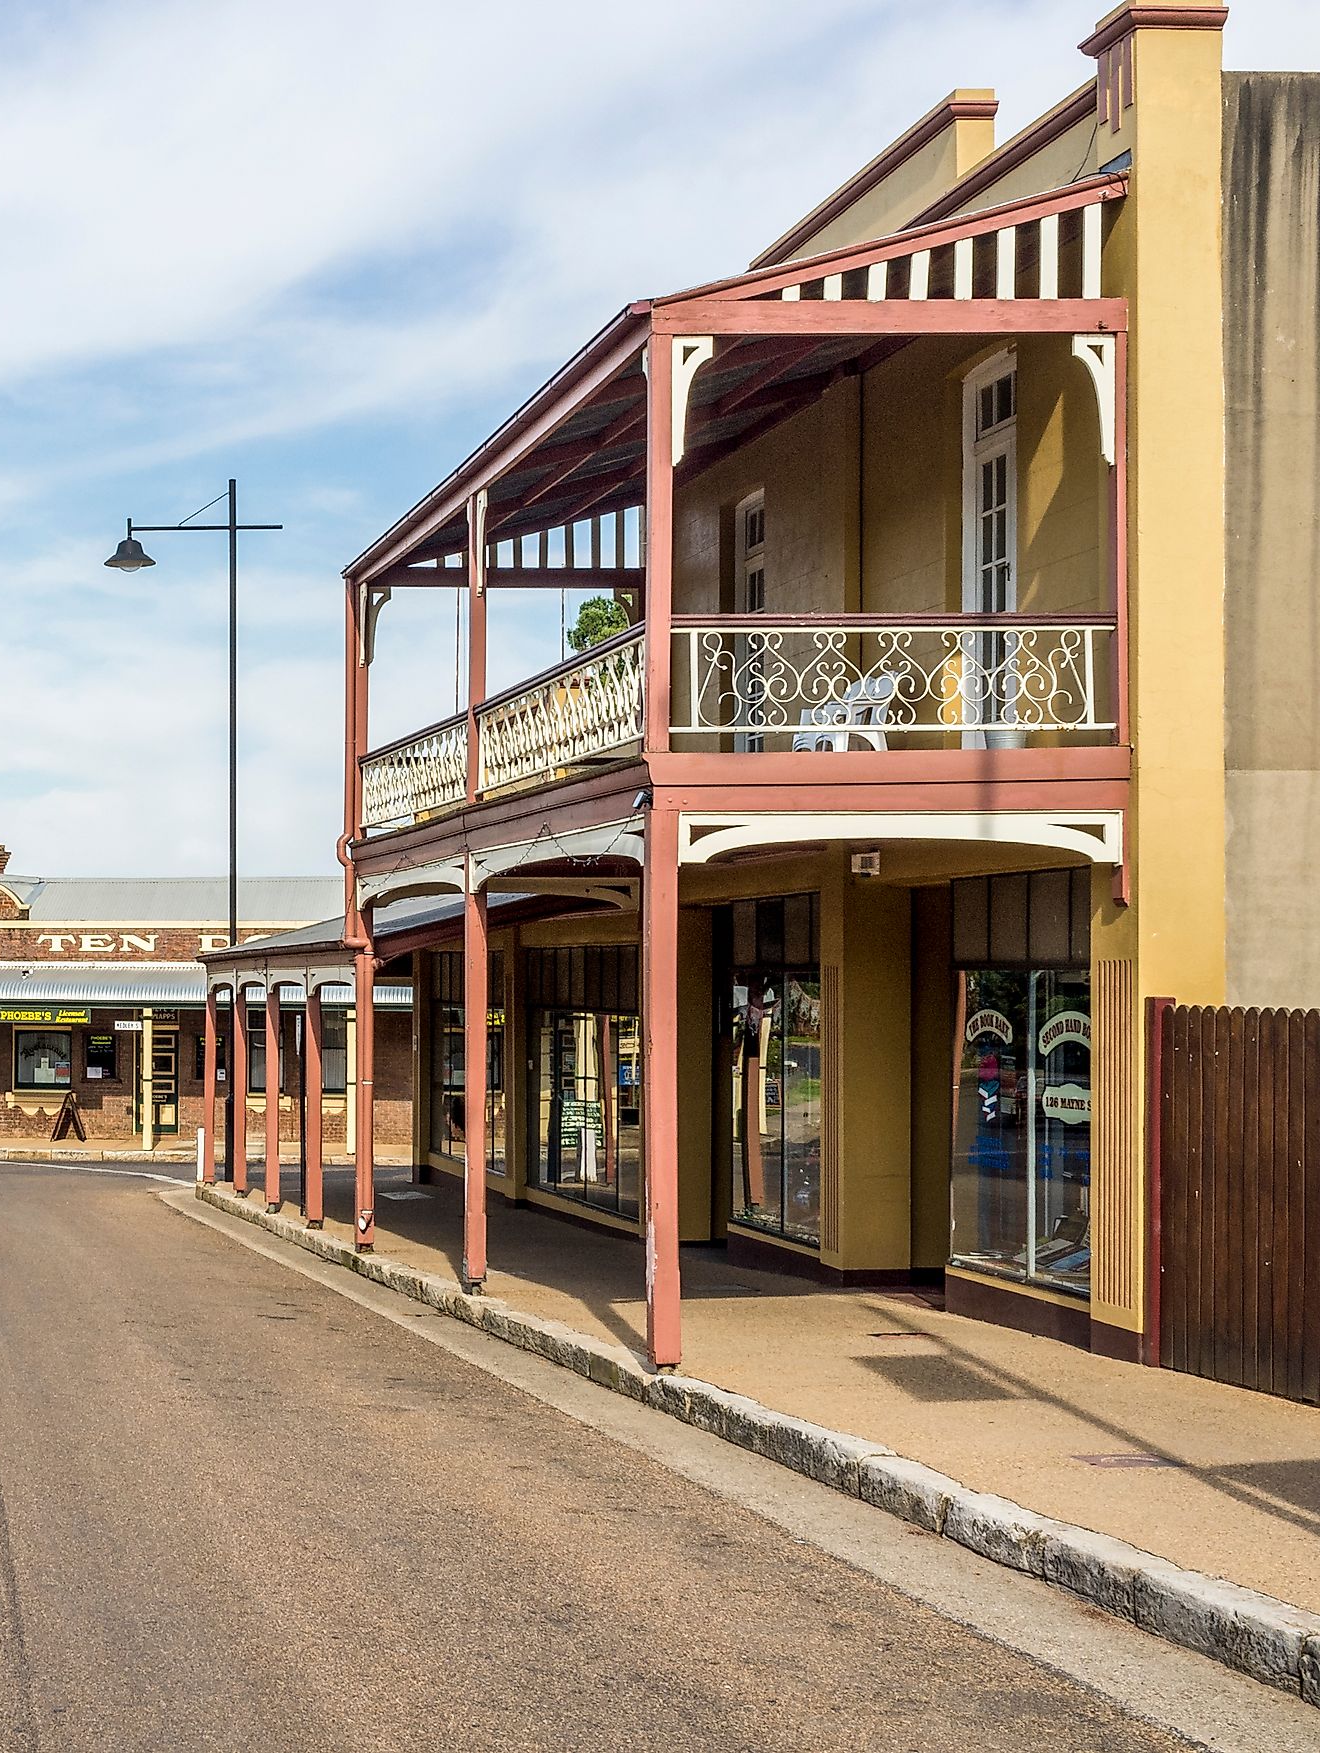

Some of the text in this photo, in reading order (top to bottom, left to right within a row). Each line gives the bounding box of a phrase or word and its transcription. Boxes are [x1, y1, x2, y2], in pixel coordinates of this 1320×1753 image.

[36, 934, 159, 953] TEN
[0, 1010, 52, 1021] PHOEBE'S
[58, 1009, 86, 1017] Licensed
[968, 1018, 980, 1036] THE
[980, 1013, 994, 1028] BOOK
[1041, 1020, 1064, 1048] SECOND
[1064, 1018, 1082, 1034] HAND
[1045, 1096, 1059, 1108] 126
[1060, 1097, 1086, 1111] MAYNE
